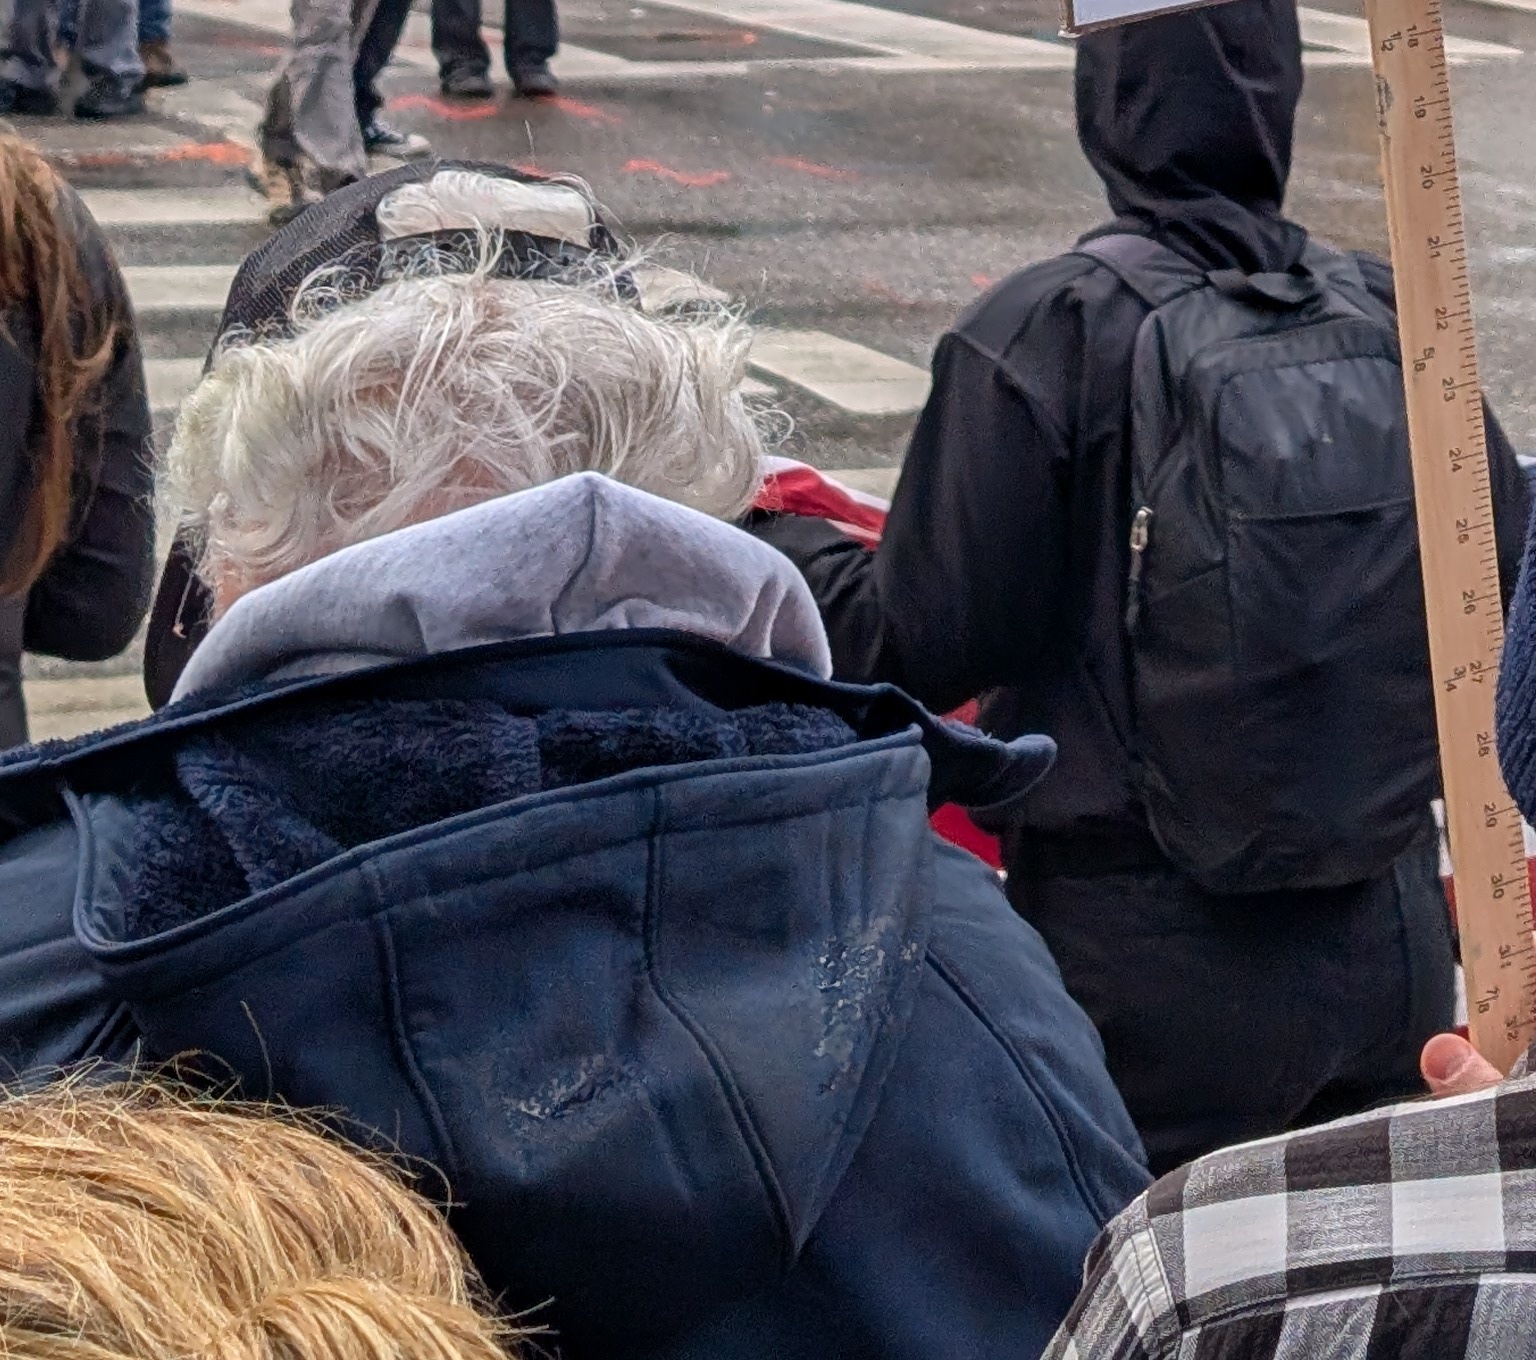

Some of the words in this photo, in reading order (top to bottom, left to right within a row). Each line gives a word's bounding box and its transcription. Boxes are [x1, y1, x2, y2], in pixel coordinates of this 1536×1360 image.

[1420, 164, 1435, 191] 20
[1427, 236, 1441, 259] 21
[1435, 306, 1449, 331] 22
[1442, 376, 1456, 403] 23
[1448, 447, 1463, 473] 24
[1490, 872, 1504, 900] 30
